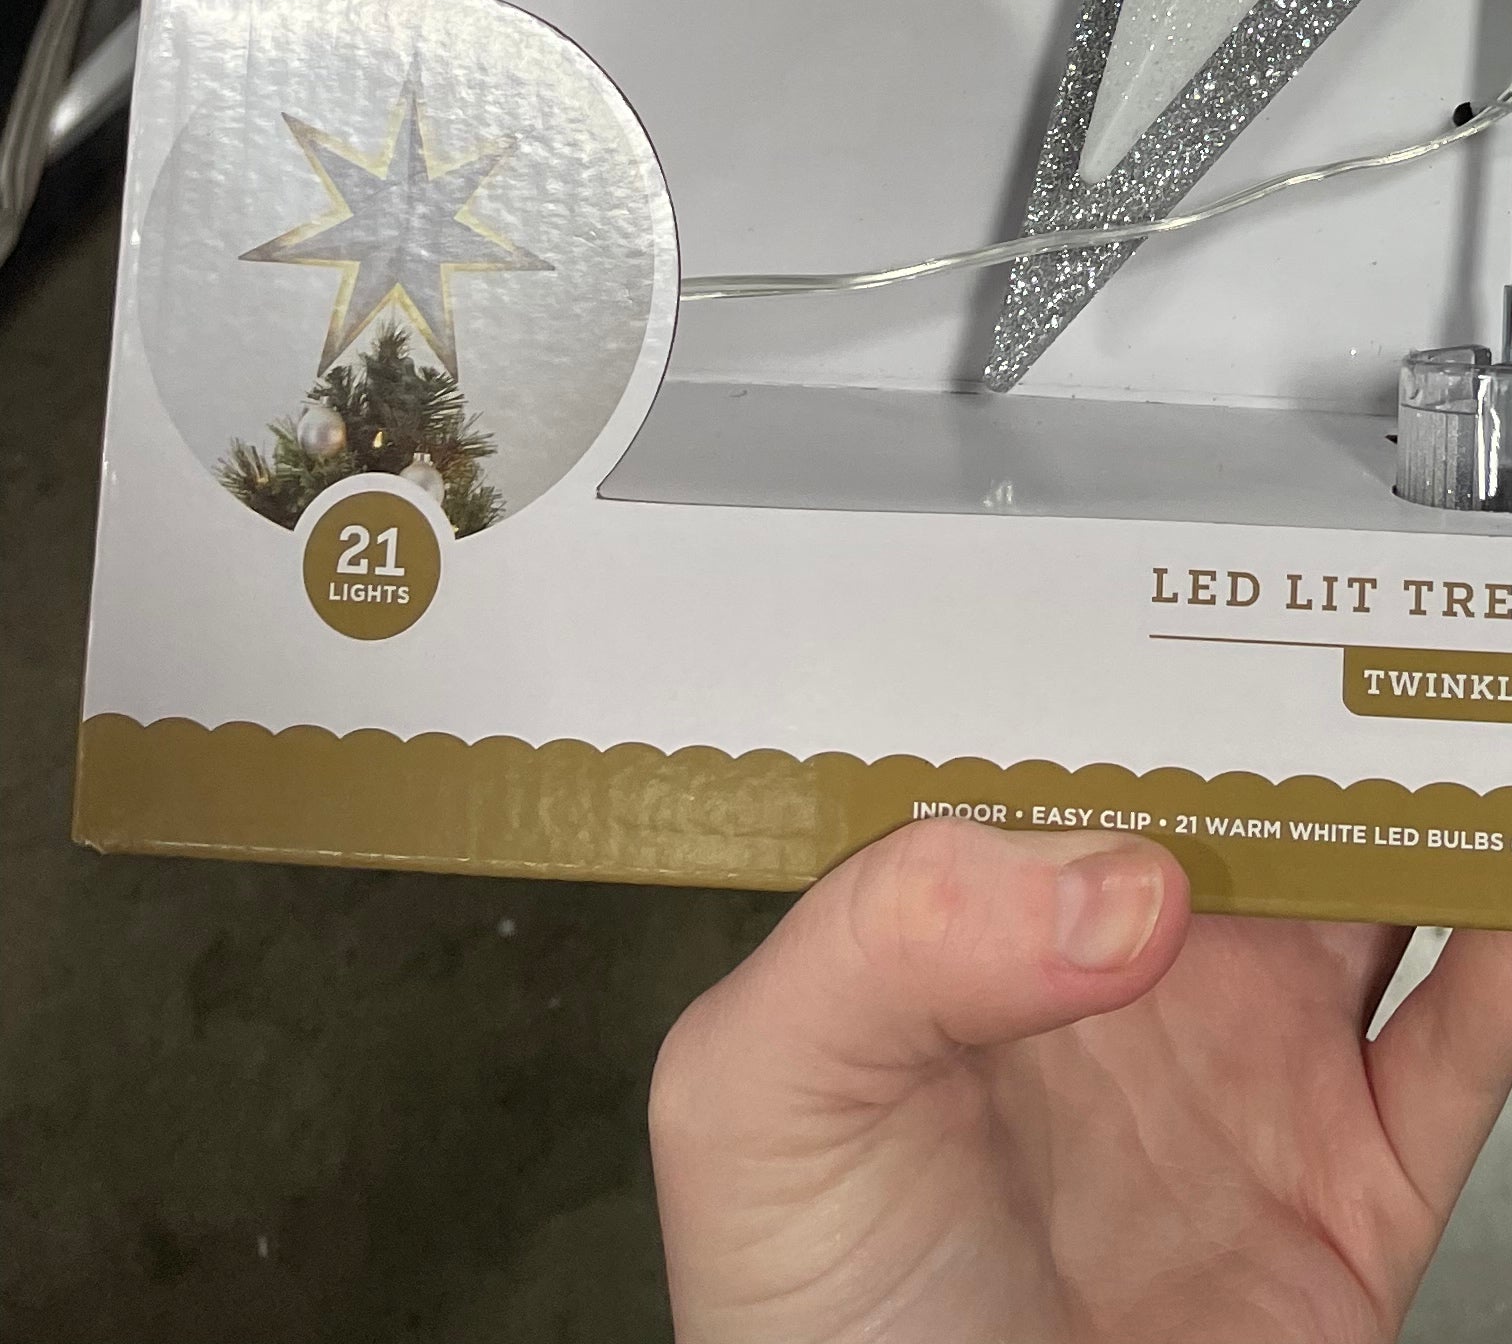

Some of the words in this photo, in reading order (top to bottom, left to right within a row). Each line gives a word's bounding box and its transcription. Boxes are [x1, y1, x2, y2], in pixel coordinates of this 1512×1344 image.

[336, 525, 405, 576] 21
[329, 582, 410, 604] LIGHTS
[1152, 567, 1261, 607] LED
[1286, 573, 1378, 614] LIT
[913, 801, 1007, 823] INDOOR
[1032, 806, 1094, 827] EASY
[1099, 810, 1152, 831] CLIP
[1175, 815, 1197, 834] 21
[1205, 816, 1281, 839] WARM
[1288, 821, 1367, 844] WHITE
[1374, 826, 1420, 846] LED
[1427, 829, 1504, 851] BULBS
